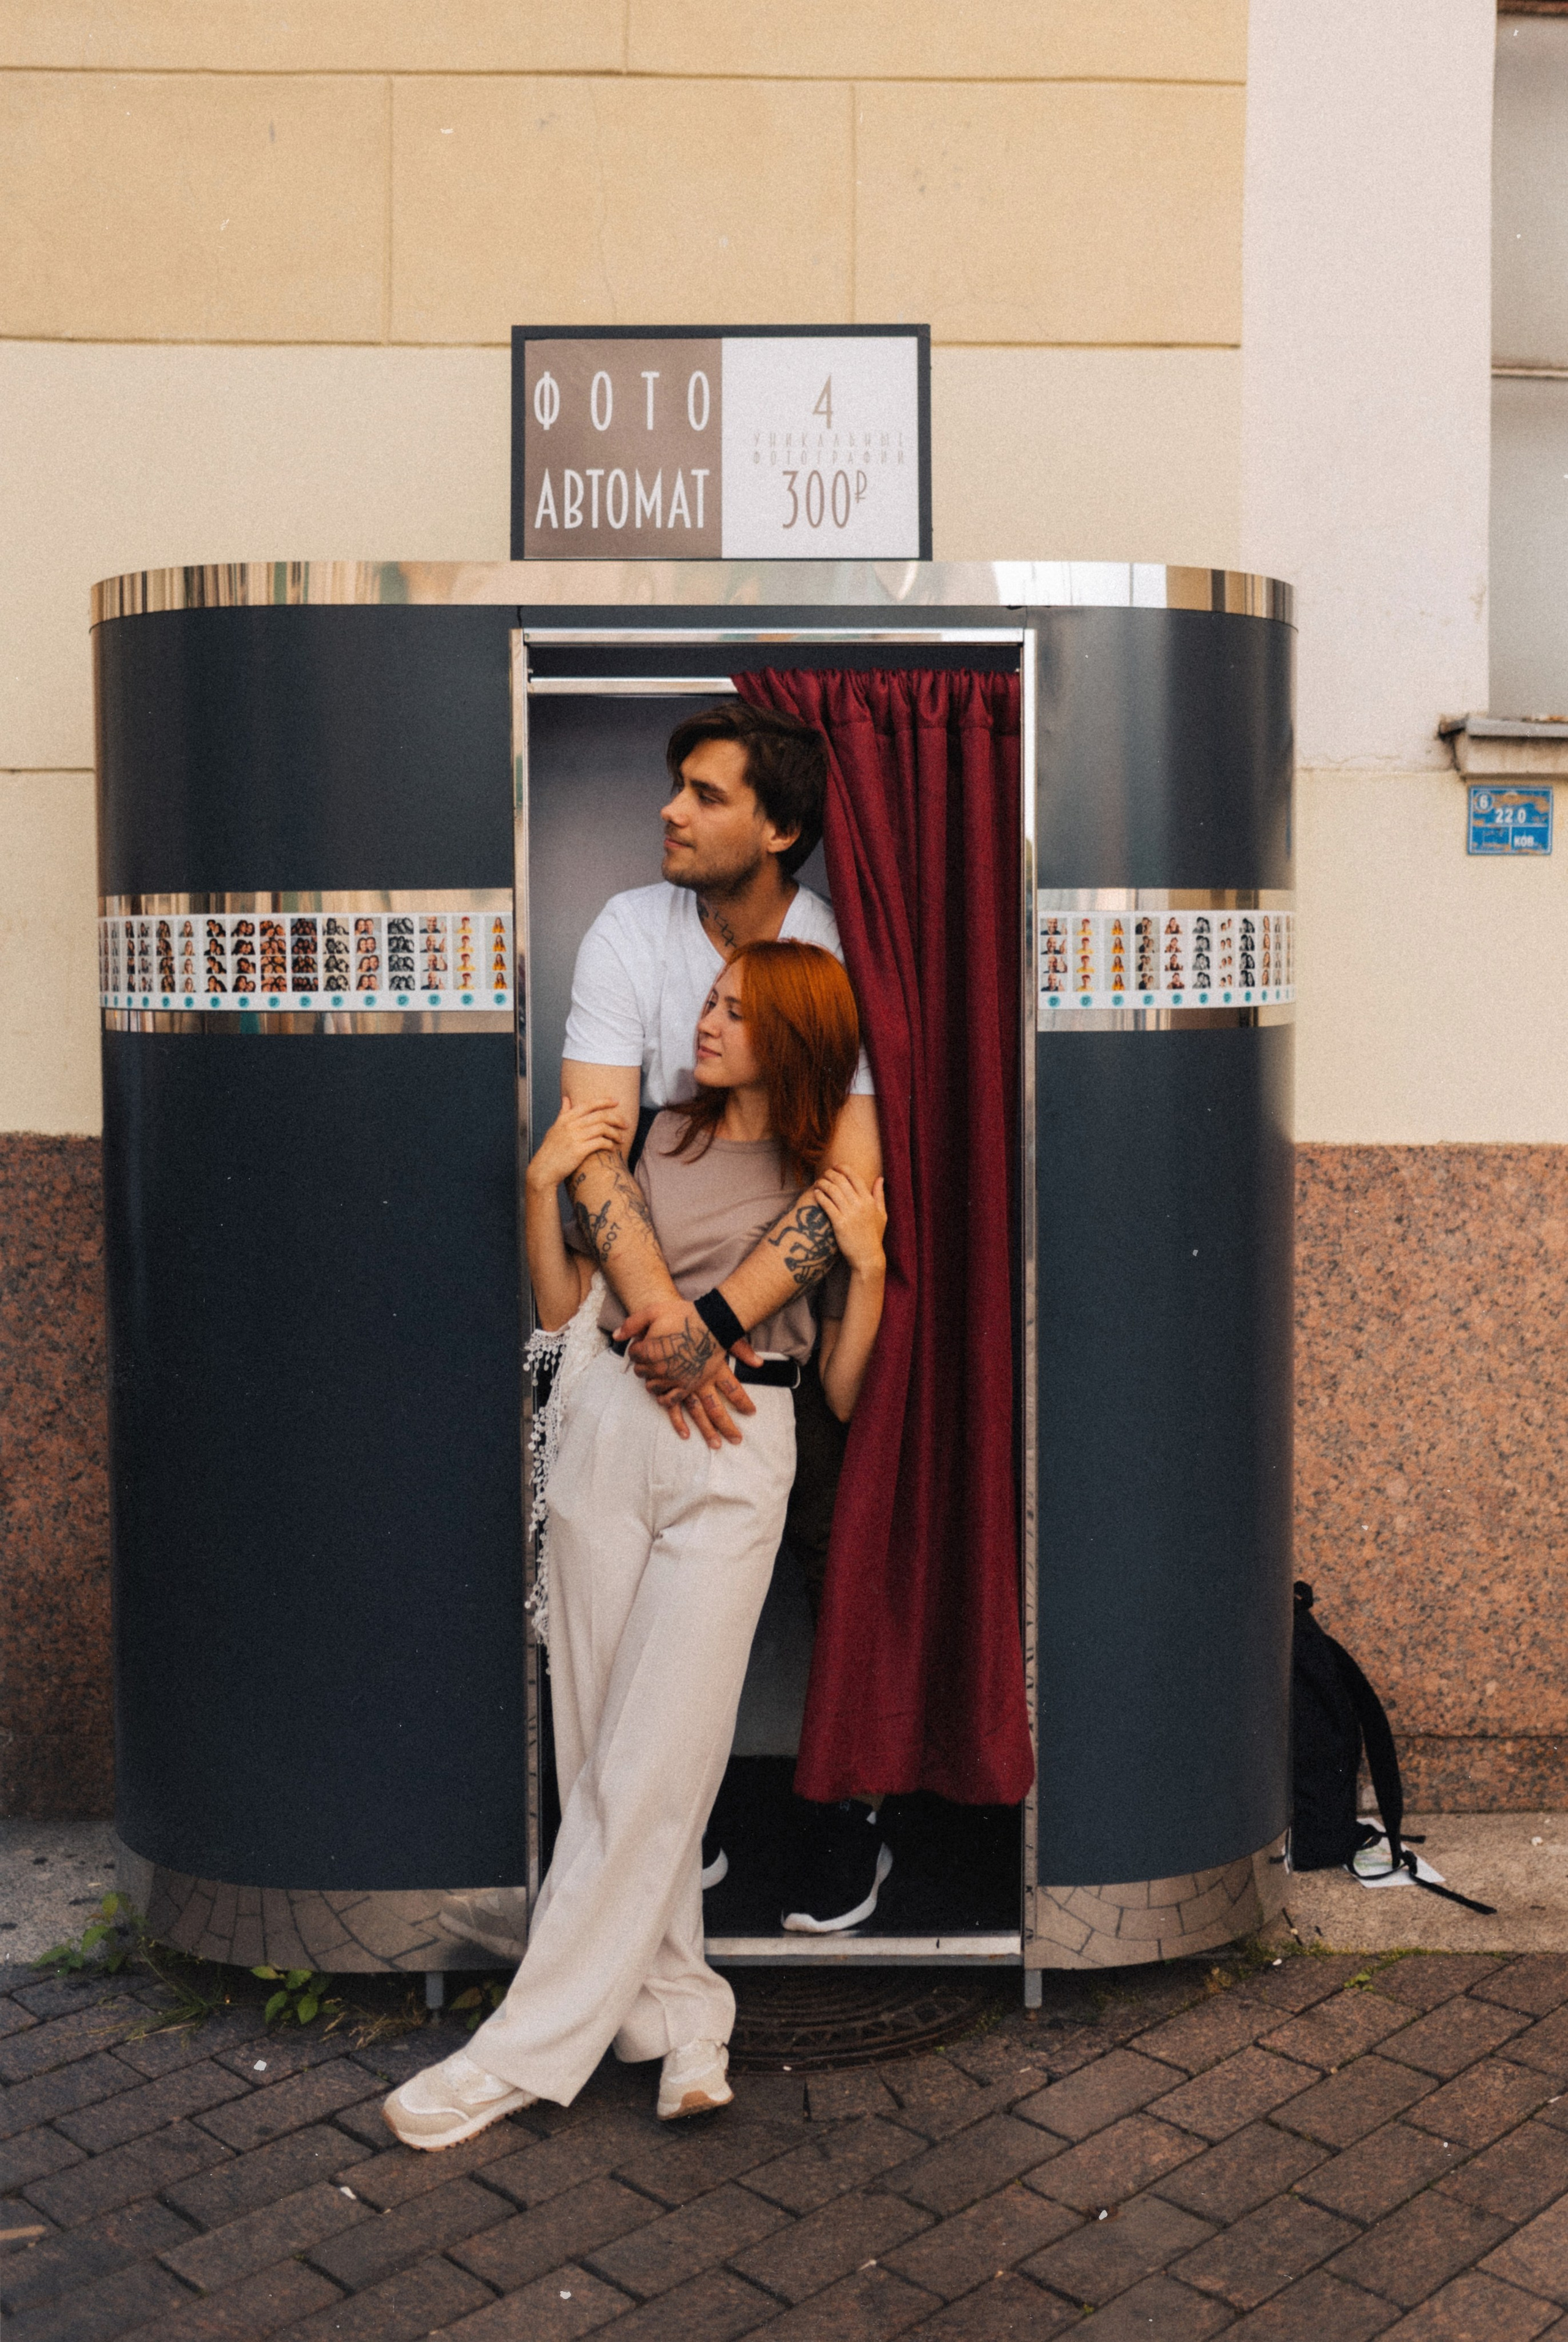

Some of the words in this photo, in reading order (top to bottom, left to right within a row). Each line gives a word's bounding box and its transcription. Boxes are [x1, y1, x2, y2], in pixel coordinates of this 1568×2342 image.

[533, 370, 710, 431] ФОТО
[811, 373, 834, 429] 4
[753, 450, 905, 465] ФОТОГРАФИИ
[533, 467, 710, 529] АВТОМАТ
[1495, 808, 1526, 824] 220
